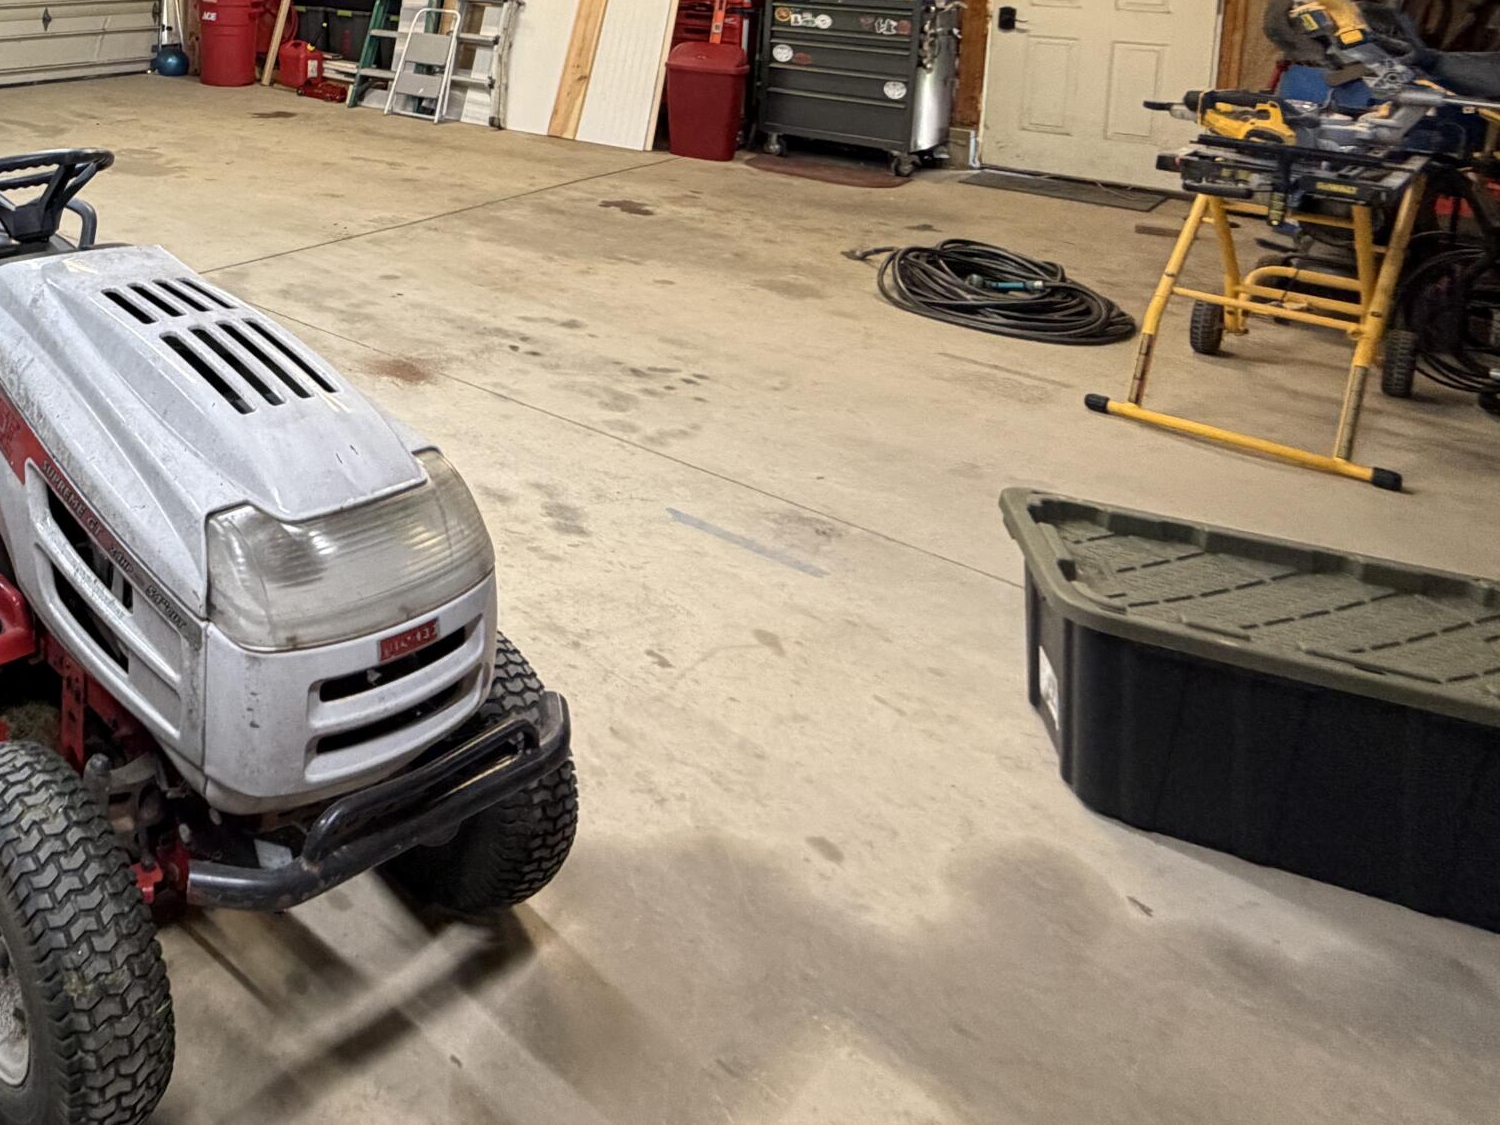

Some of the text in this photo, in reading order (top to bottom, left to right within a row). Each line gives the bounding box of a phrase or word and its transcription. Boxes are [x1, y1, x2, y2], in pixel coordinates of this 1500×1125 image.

[202, 11, 217, 21] ACE
[42, 459, 86, 517] SUPREME
[86, 517, 106, 536] GT
